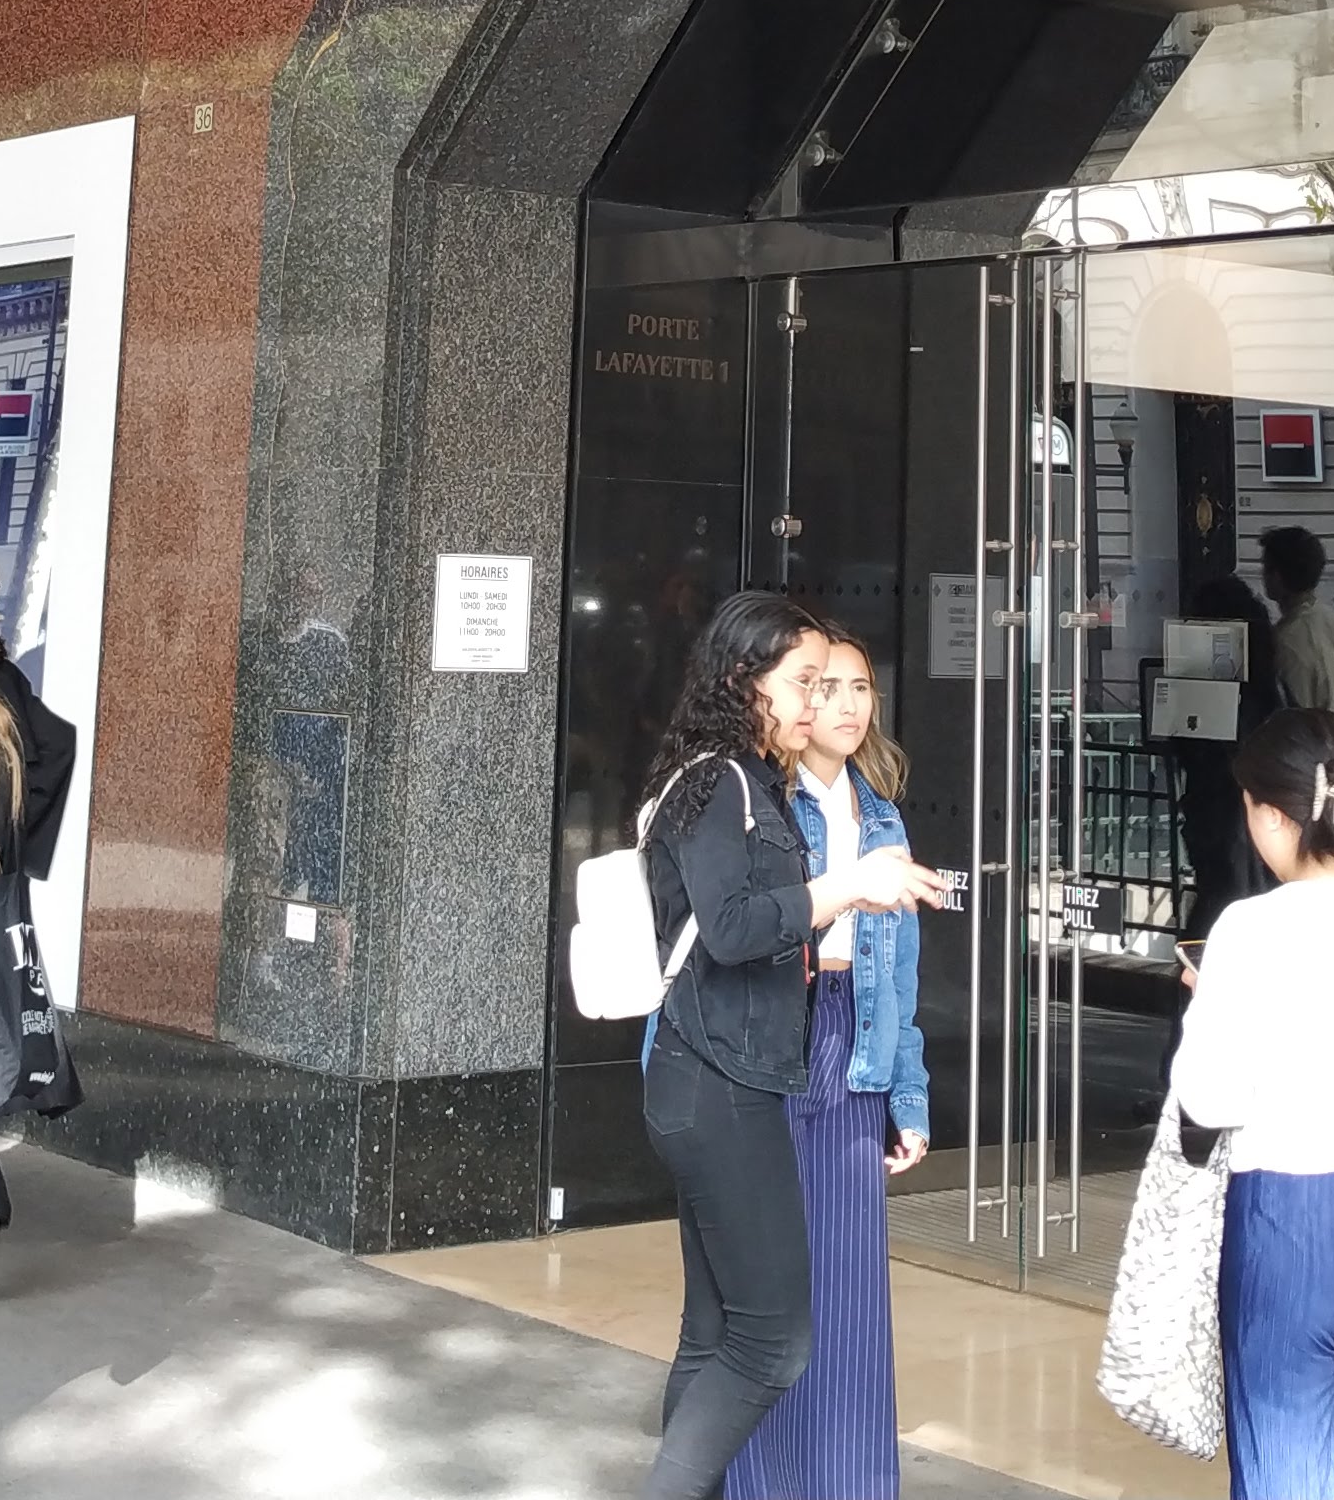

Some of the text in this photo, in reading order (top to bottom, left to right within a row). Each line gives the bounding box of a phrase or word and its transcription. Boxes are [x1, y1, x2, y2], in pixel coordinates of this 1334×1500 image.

[195, 105, 212, 131] 36
[627, 313, 700, 341] PORTE
[595, 350, 730, 384] LAFAYETTE 1
[460, 565, 509, 579] HORAIRES
[459, 591, 479, 600] LUNDI
[484, 592, 508, 601] SAMEDI
[466, 617, 499, 626] DIMANCHE
[1063, 885, 1100, 908] TIREZ
[1063, 907, 1095, 930] PULL
